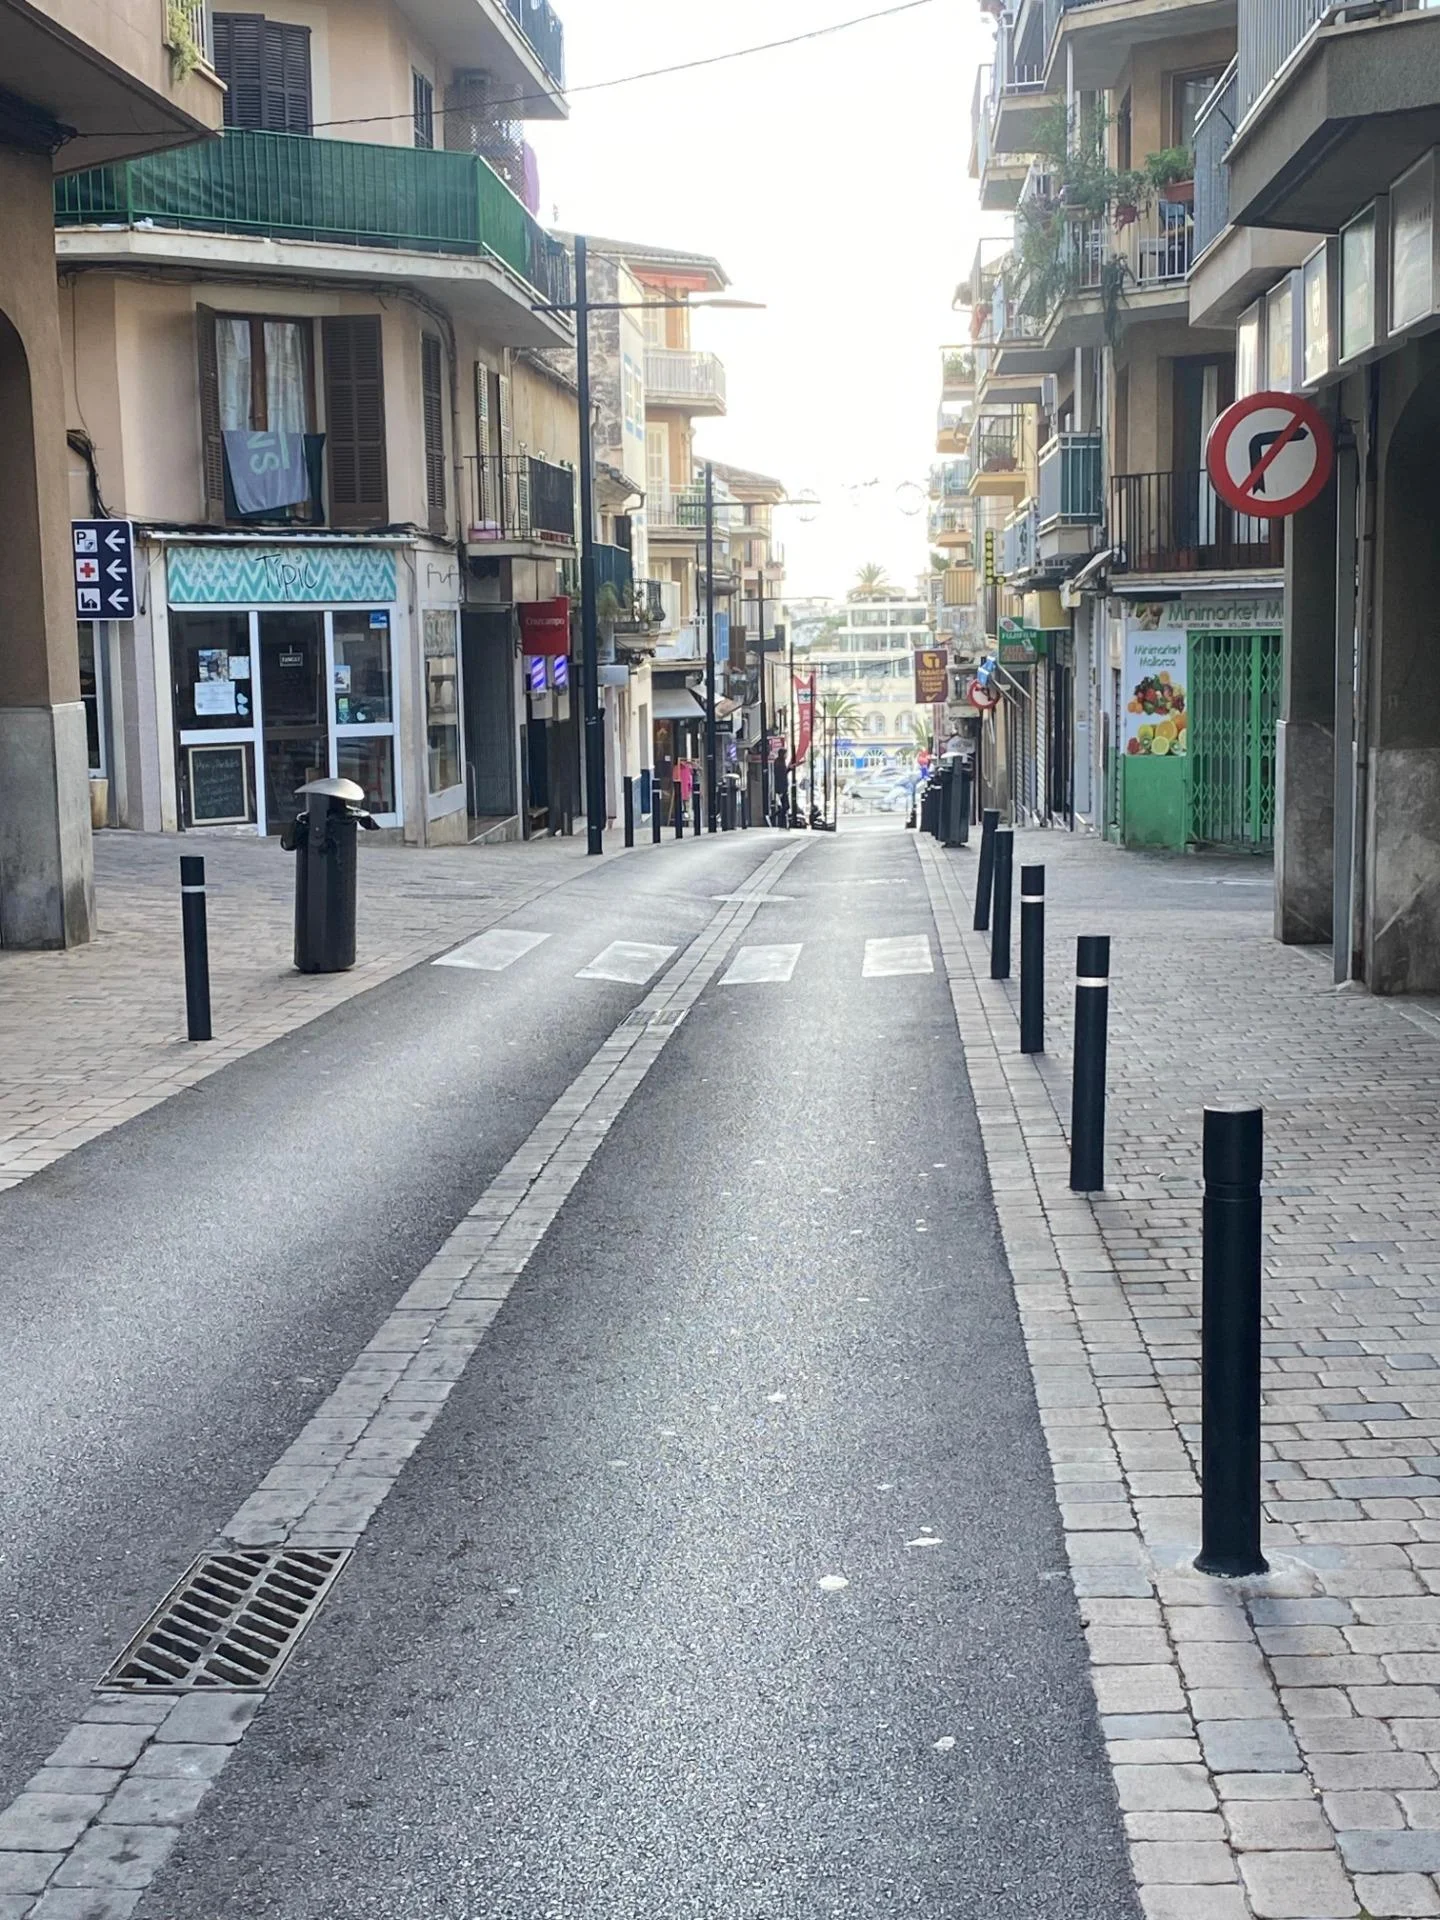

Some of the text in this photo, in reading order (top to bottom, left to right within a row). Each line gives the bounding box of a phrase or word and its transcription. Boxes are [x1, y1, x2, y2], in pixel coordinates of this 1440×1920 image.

[76, 531, 87, 545] P
[1168, 600, 1260, 621] Minimarket
[525, 616, 565, 627] Cruzcampo
[1001, 631, 1037, 640] FUJIFILM
